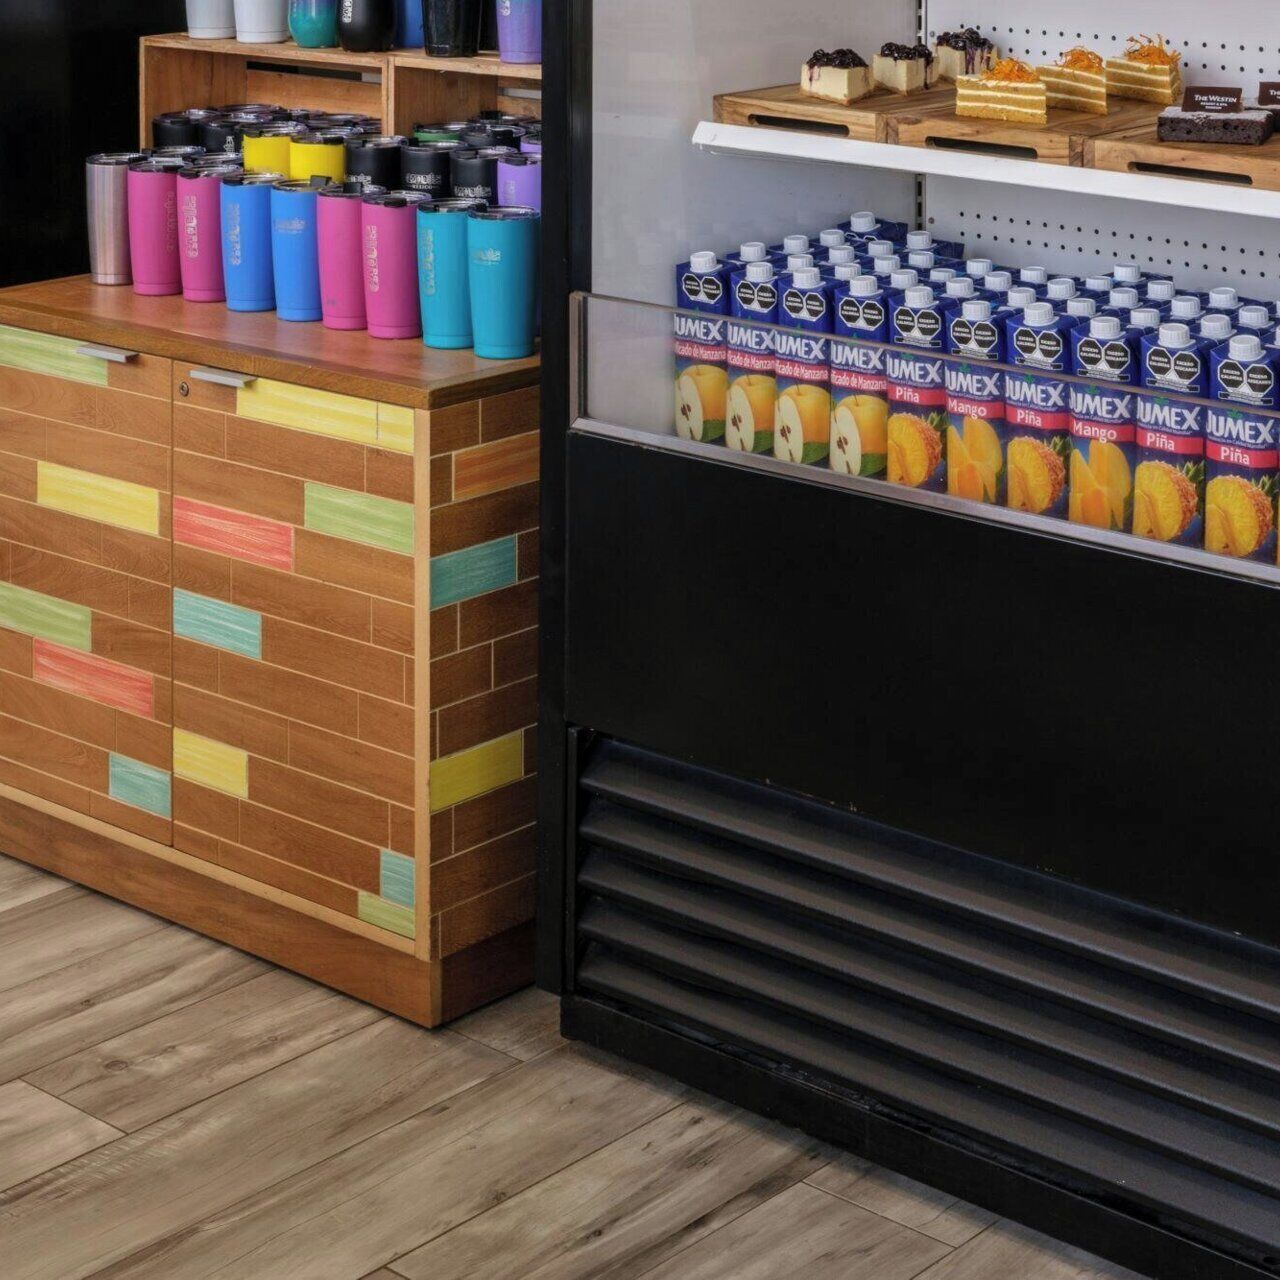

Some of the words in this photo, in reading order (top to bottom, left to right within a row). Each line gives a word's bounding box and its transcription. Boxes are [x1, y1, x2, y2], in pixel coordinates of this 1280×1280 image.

[895, 387, 920, 403] Piña
[948, 399, 988, 420] Mango
[1016, 409, 1043, 427] Piña
[1073, 420, 1117, 444] Mango
[1206, 409, 1275, 444] JUMEX
[1146, 432, 1176, 452] Piña
[1220, 446, 1251, 466] Piña
